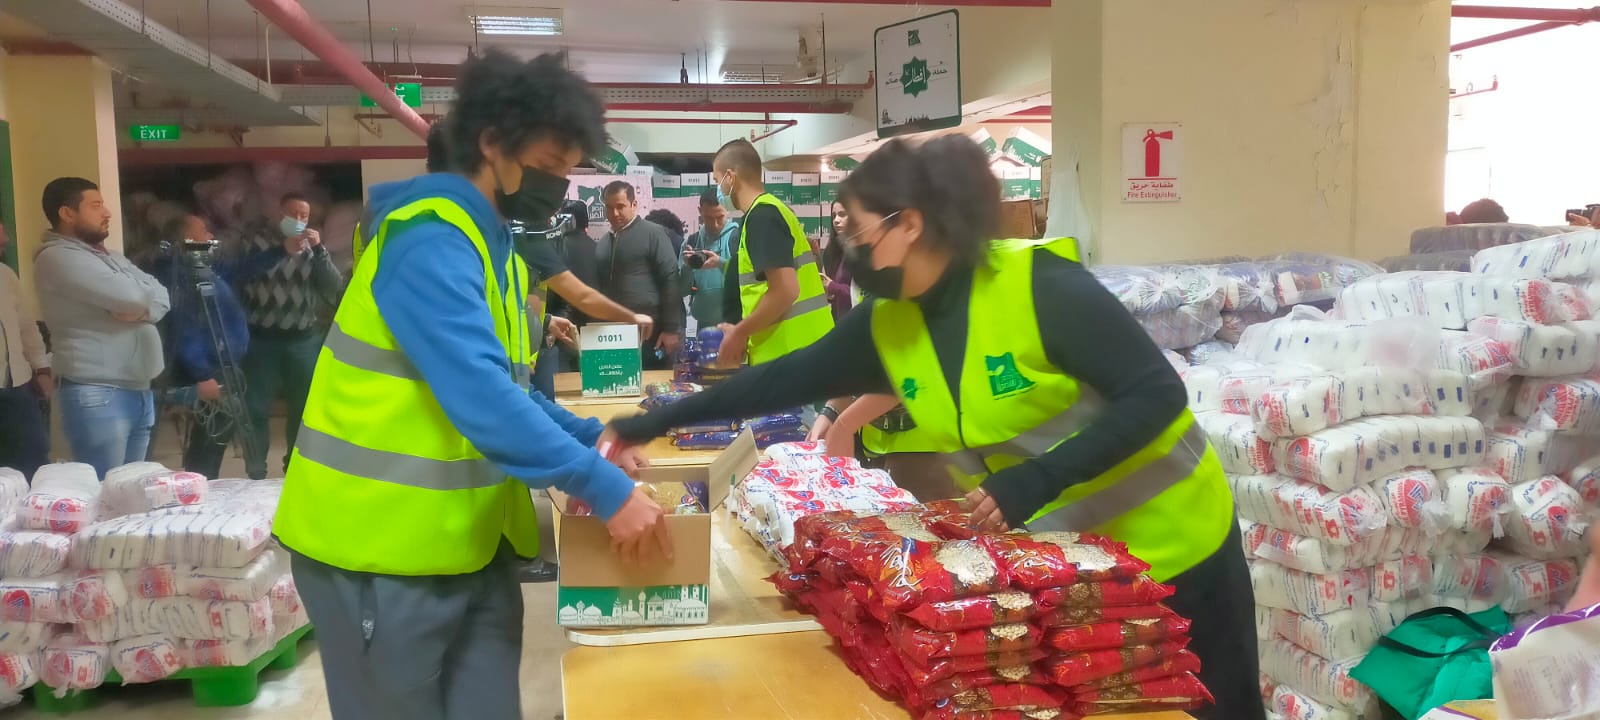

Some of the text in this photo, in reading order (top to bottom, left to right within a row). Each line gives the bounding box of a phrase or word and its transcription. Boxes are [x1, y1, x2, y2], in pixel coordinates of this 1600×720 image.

[140, 129, 167, 139] EXIT
[1130, 181, 1149, 190] حريق
[597, 334, 622, 342] 01011
